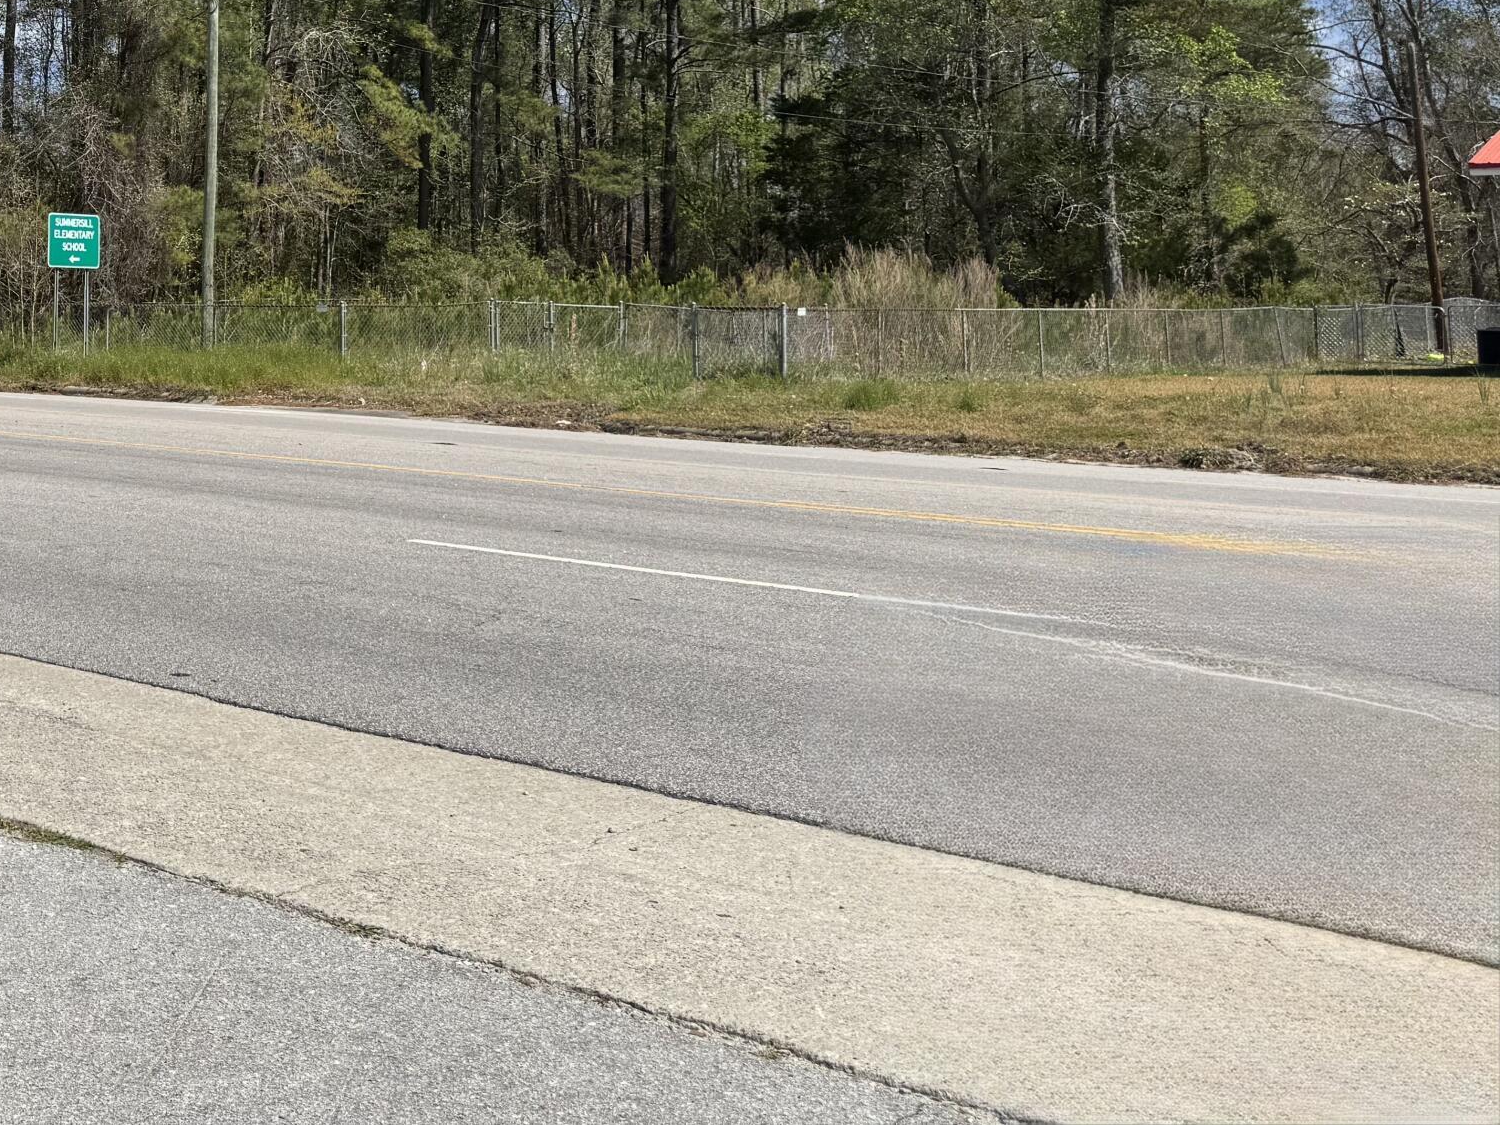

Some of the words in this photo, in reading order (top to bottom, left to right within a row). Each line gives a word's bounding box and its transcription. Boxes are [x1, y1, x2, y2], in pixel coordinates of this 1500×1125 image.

[55, 218, 93, 228] SUMMERSILL
[54, 229, 94, 239] ELEMENTARY
[62, 242, 87, 252] SCHOOL
